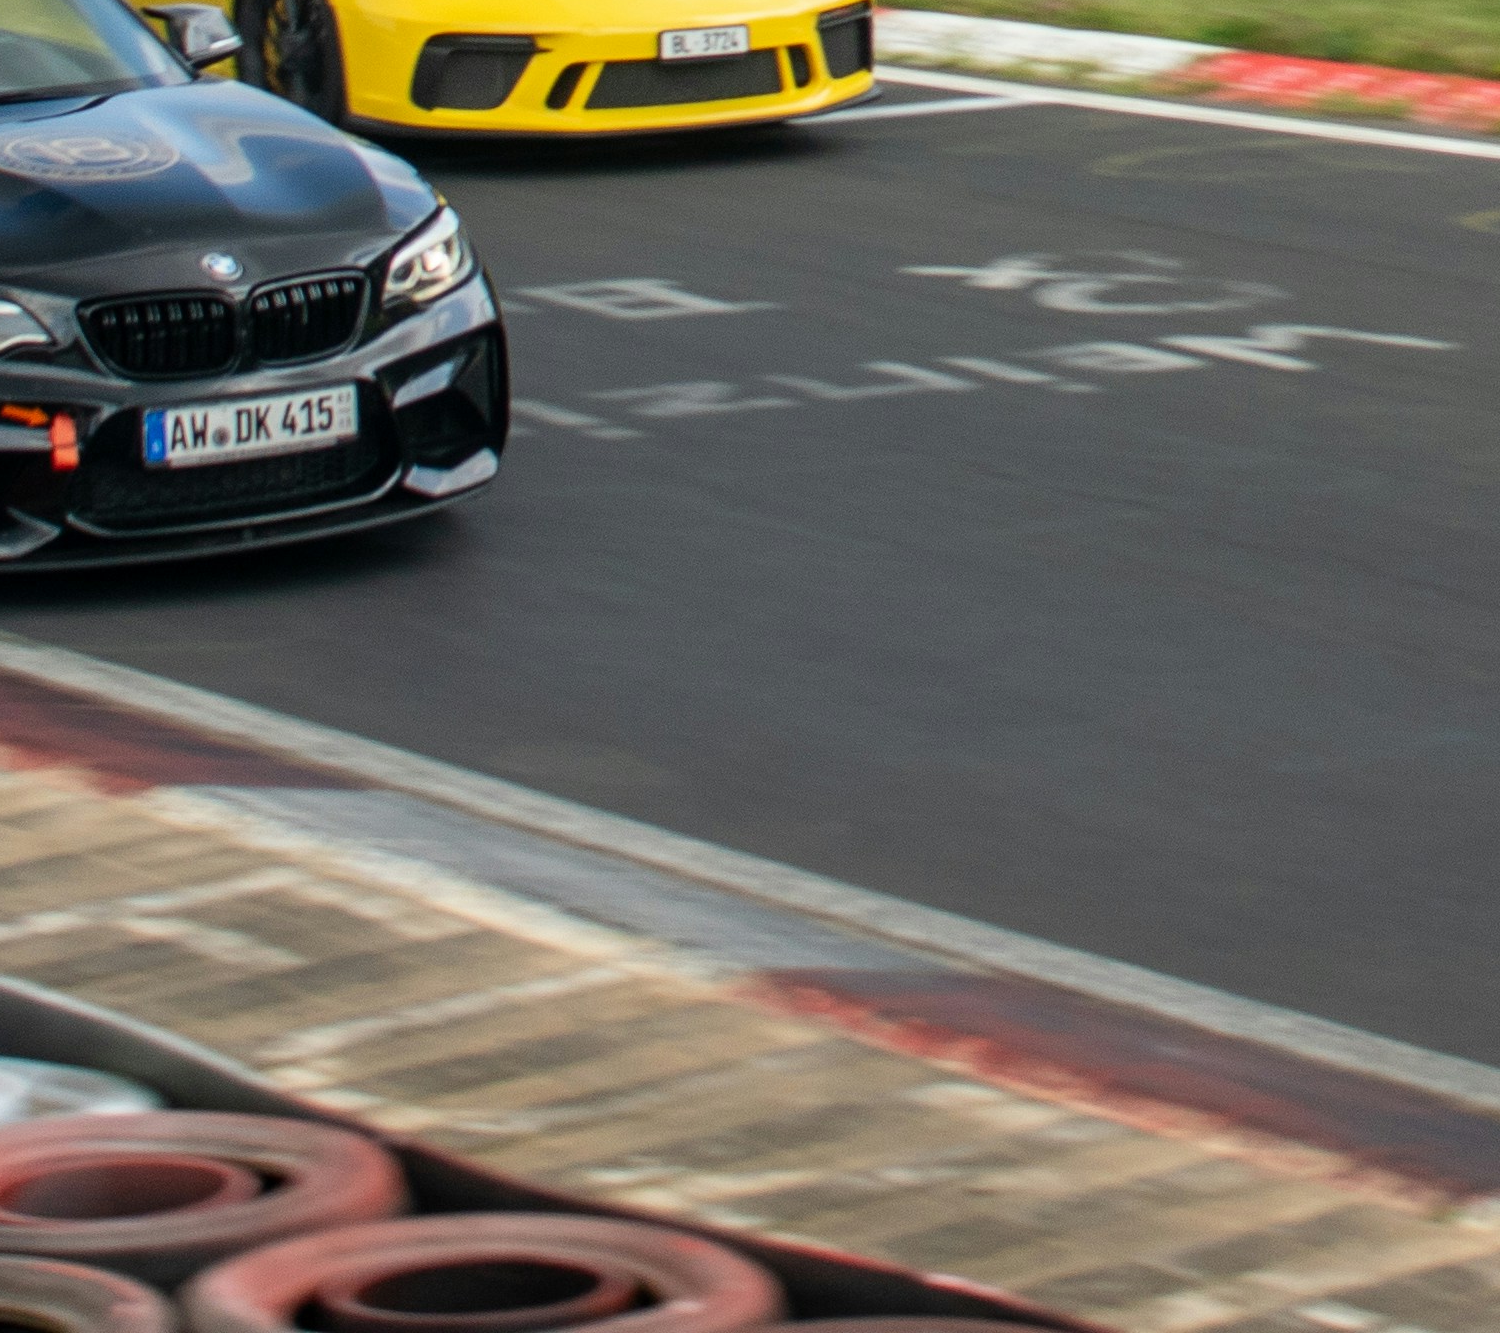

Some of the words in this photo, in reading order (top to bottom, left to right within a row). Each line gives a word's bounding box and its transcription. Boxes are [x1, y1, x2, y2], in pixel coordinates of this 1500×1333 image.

[171, 412, 210, 452] AW
[236, 404, 272, 443] DK
[282, 395, 334, 436] 415
